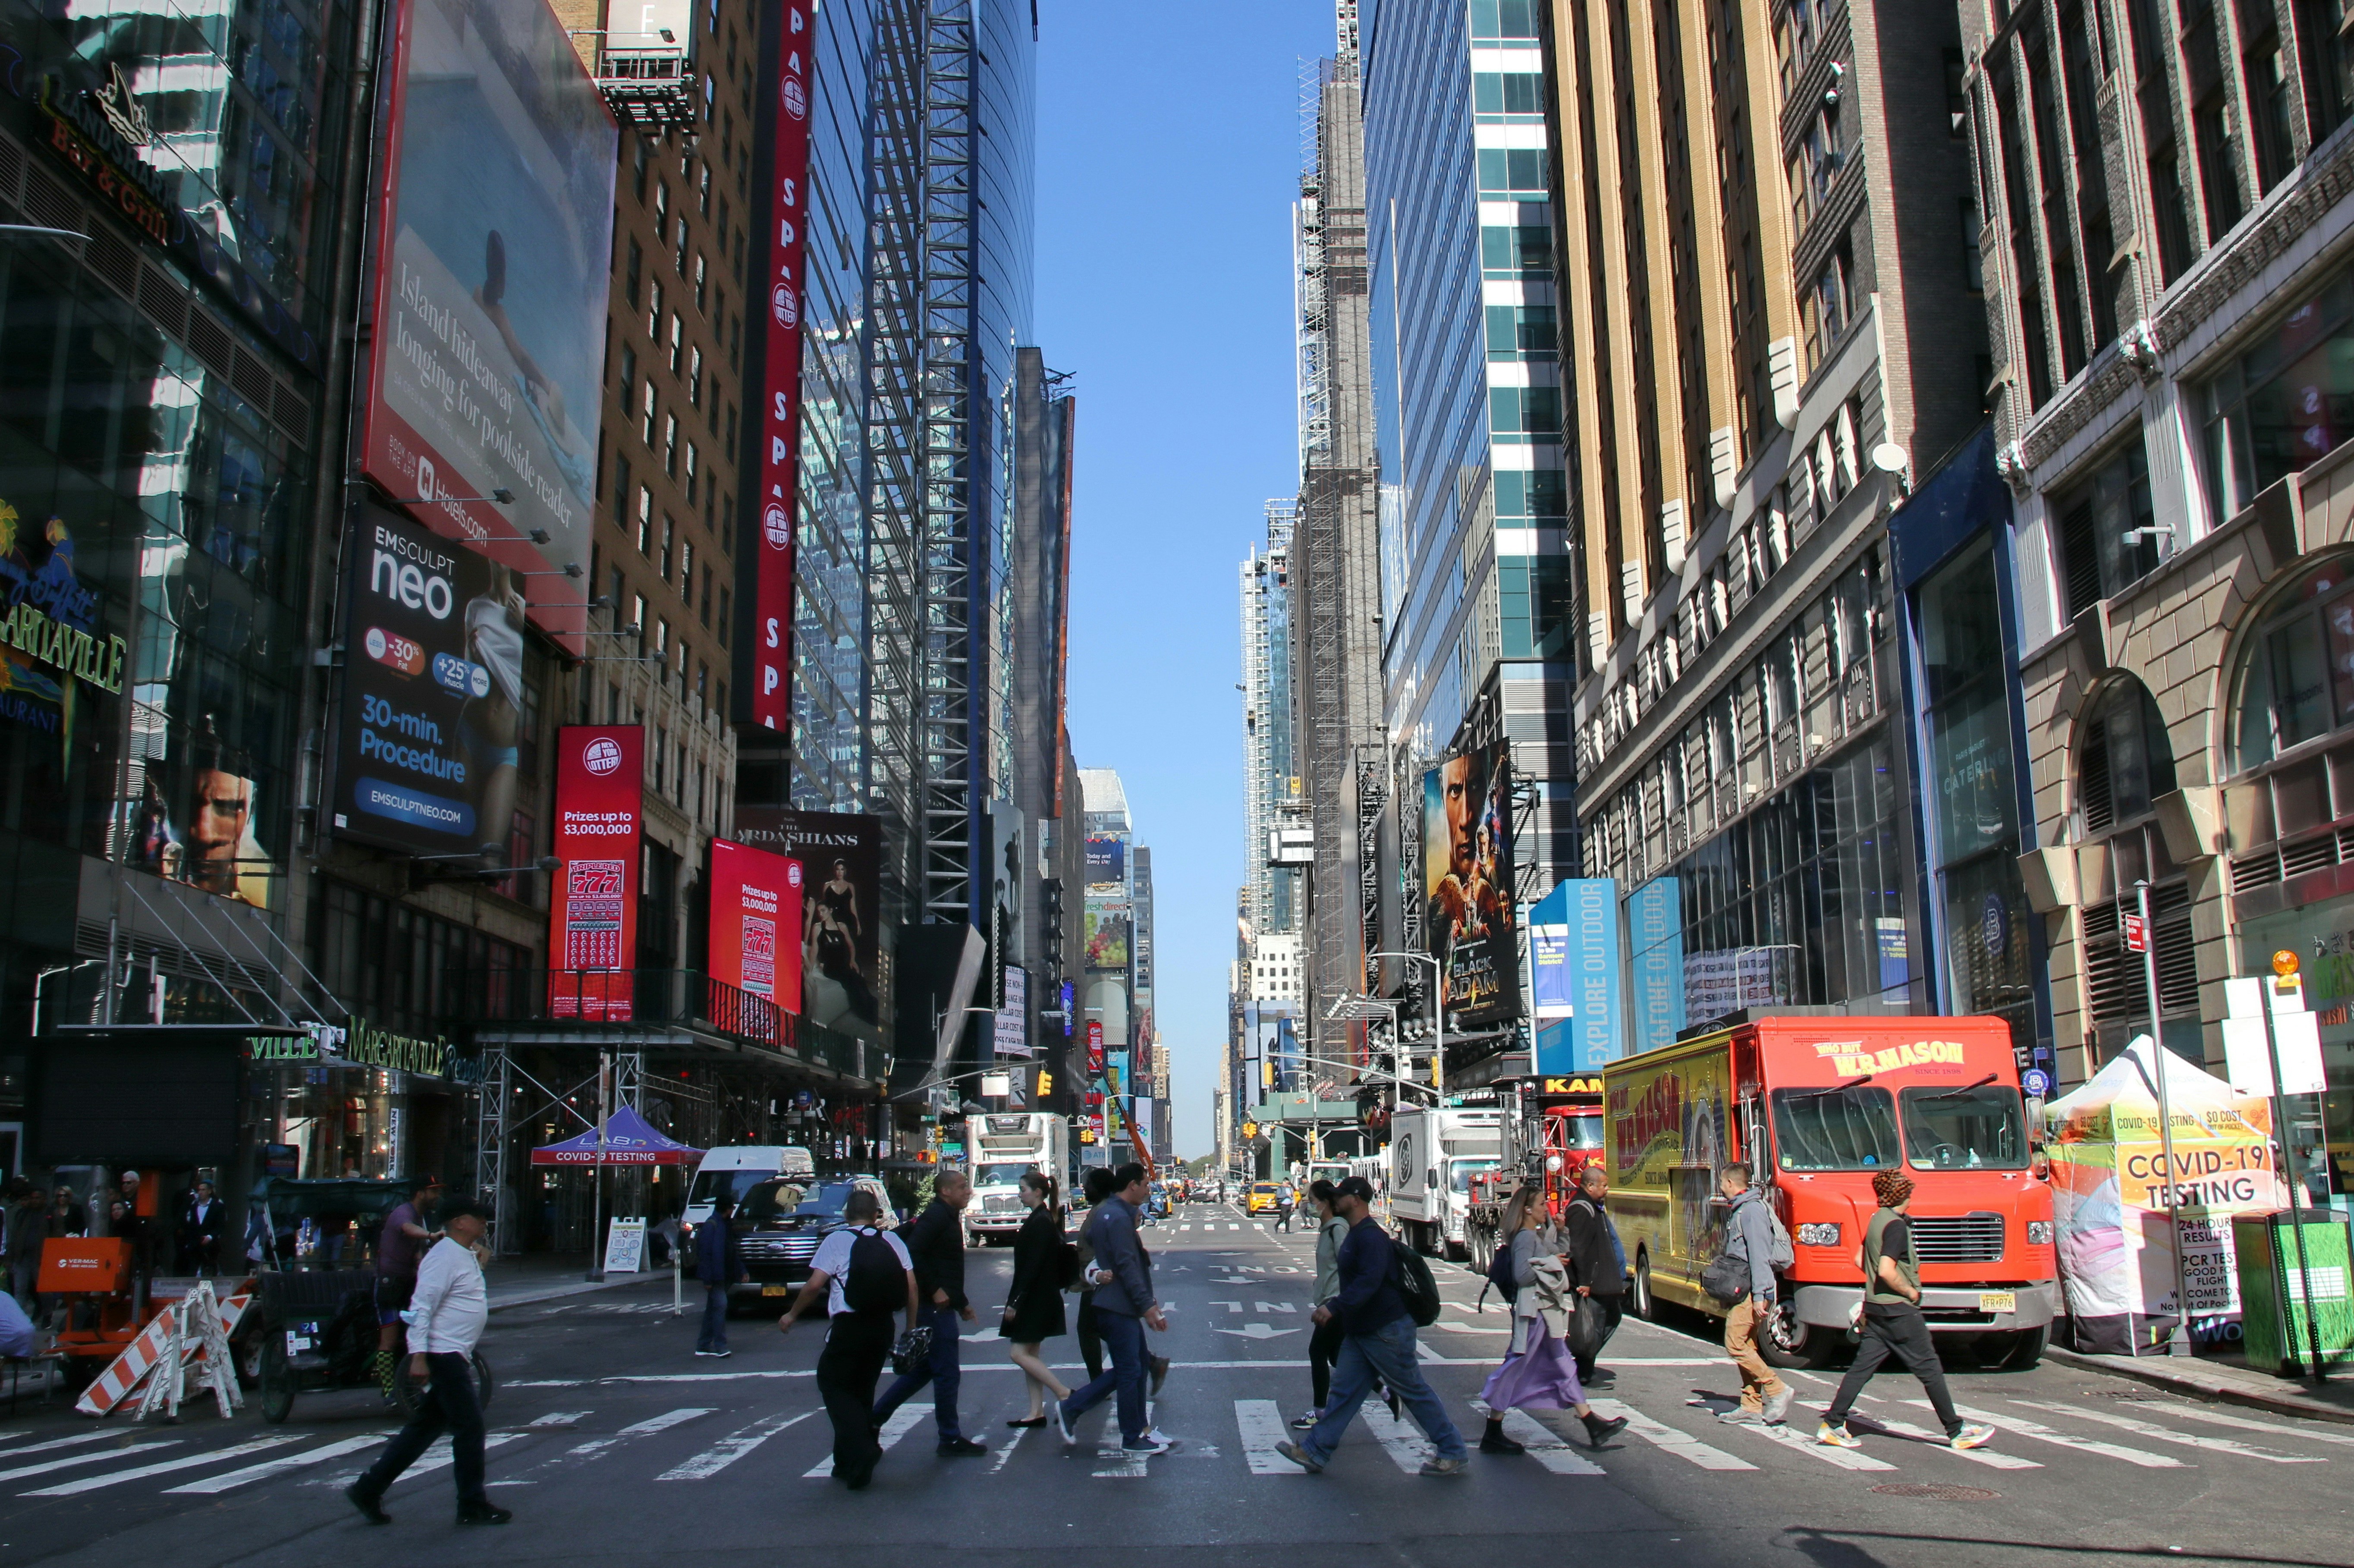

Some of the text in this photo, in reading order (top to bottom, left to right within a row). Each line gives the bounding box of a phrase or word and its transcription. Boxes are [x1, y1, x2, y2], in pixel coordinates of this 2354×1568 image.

[784, 94, 805, 116] LOTTERY
[52, 119, 167, 247] Bar & Grill
[775, 305, 796, 323] LOTTERY
[402, 261, 516, 425] Island hideaway
[395, 311, 573, 529] longing for poolside reader
[390, 434, 416, 467] BOOK ON
[389, 449, 415, 480] THE APP
[436, 478, 489, 548] Hotels.com
[766, 527, 789, 544] LOTTERY
[375, 525, 455, 576] EMSCULPT
[371, 548, 453, 620] neo
[0, 602, 127, 695] ARITAVILLE
[369, 637, 383, 649] LESS
[398, 660, 408, 670] Fat
[444, 676, 465, 690] Muscle
[473, 676, 487, 687] MORE
[362, 694, 443, 745] 30-min.
[361, 728, 466, 783] Procedure
[602, 748, 618, 757] YORK
[587, 756, 620, 771] LOTTERY
[1944, 748, 2006, 795] CATERING
[371, 790, 462, 823] EMSCULPTNEO.COM
[564, 811, 632, 823] Prizes up to
[564, 823, 632, 836] $3,000,000
[733, 829, 858, 846] ARDASHIANS
[572, 863, 620, 873] TRIPLE RED
[572, 870, 620, 893] 777
[742, 884, 778, 902] Prizes up to
[742, 895, 777, 914] $3,000,000
[745, 927, 775, 955] 777
[1453, 955, 1493, 978] BLACK
[1580, 883, 1611, 1065] EXPLORE OUTDOOR
[1447, 971, 1499, 1002] ADAM
[2319, 1004, 2348, 1027] sushi
[246, 1028, 320, 1059] VILLE
[348, 1015, 446, 1076] MARGARITAVILLE
[1816, 1043, 1861, 1054] WHO BUT
[1832, 1041, 1964, 1077] W.B.MASON
[2117, 1116, 2157, 1129] COVID-19
[2206, 1109, 2242, 1124] $0 COST
[943, 1122, 957, 1131] ASE
[389, 1110, 398, 1172] NEW YORK
[609, 1151, 656, 1162] TESTING
[2128, 1146, 2266, 1179] COVID-19
[1645, 1172, 1658, 1185] SINCE
[2145, 1178, 2255, 1210] TESTING
[2178, 1221, 2194, 1234] 24
[2184, 1229, 2231, 1243] RESULTS
[2182, 1254, 2209, 1268] PCR
[2184, 1267, 2217, 1277] GOOD
[2197, 1276, 2228, 1285] FLIGHT
[2220, 1287, 2232, 1295] TO
[1982, 1298, 2013, 1308] XFR P76
[2160, 1298, 2238, 1311] No Of Pocke
